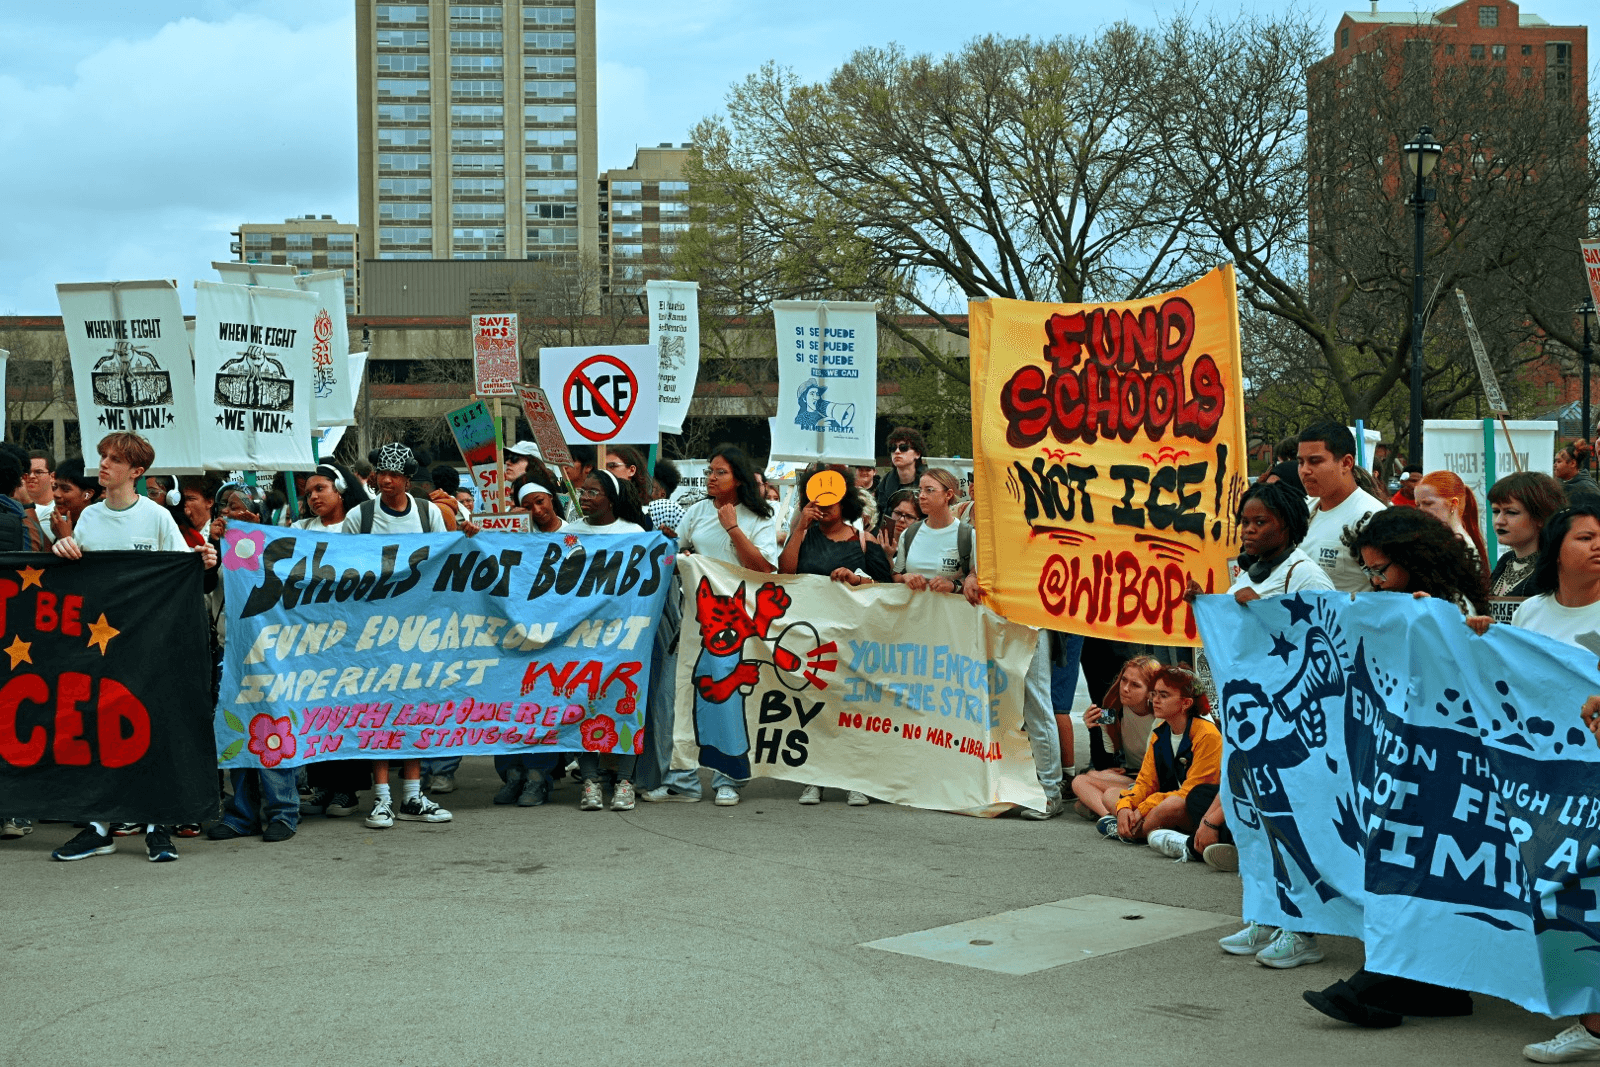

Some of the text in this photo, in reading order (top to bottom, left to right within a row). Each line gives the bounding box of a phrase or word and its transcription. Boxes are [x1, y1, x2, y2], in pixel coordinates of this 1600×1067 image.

[85, 319, 161, 339] WHEN WE FIGHT
[219, 322, 297, 348] WHEN WE FIGHT
[479, 317, 510, 326] SAVE
[481, 327, 508, 337] MPS
[795, 327, 855, 339] SI SE PUEDE
[1043, 297, 1195, 374] FUND
[795, 340, 854, 352] SI SE PUEDE
[795, 353, 854, 365] SI SE PUEDE
[572, 375, 631, 417] ICE
[1000, 354, 1225, 448] SCHOOLS
[105, 408, 166, 430] WE WIN!
[224, 409, 285, 433] WE WIN!
[828, 425, 854, 434] HUERTA
[691, 477, 698, 487] WE
[1013, 444, 1228, 541] NOT ICE!
[483, 518, 520, 529] SAVE
[942, 558, 957, 566] YES!
[1319, 547, 1339, 559] YES!
[433, 549, 522, 597] NOT
[527, 542, 668, 601] BOMBS
[35, 591, 84, 637] BE
[243, 611, 651, 664] FUND EDUCATION NOT
[848, 640, 928, 674] YOUTH
[235, 658, 643, 704] IMPERIALIST WAR
[843, 677, 882, 702] IN
[889, 681, 935, 712] THE
[299, 697, 586, 735] YOUTH EMPOWERED
[759, 690, 825, 728] BV
[303, 726, 560, 759] IN THE STRUGGLE
[755, 727, 809, 767] HS
[838, 712, 863, 729] NO
[865, 716, 892, 733] ICE
[902, 723, 922, 740] NO
[926, 727, 953, 749] WAR
